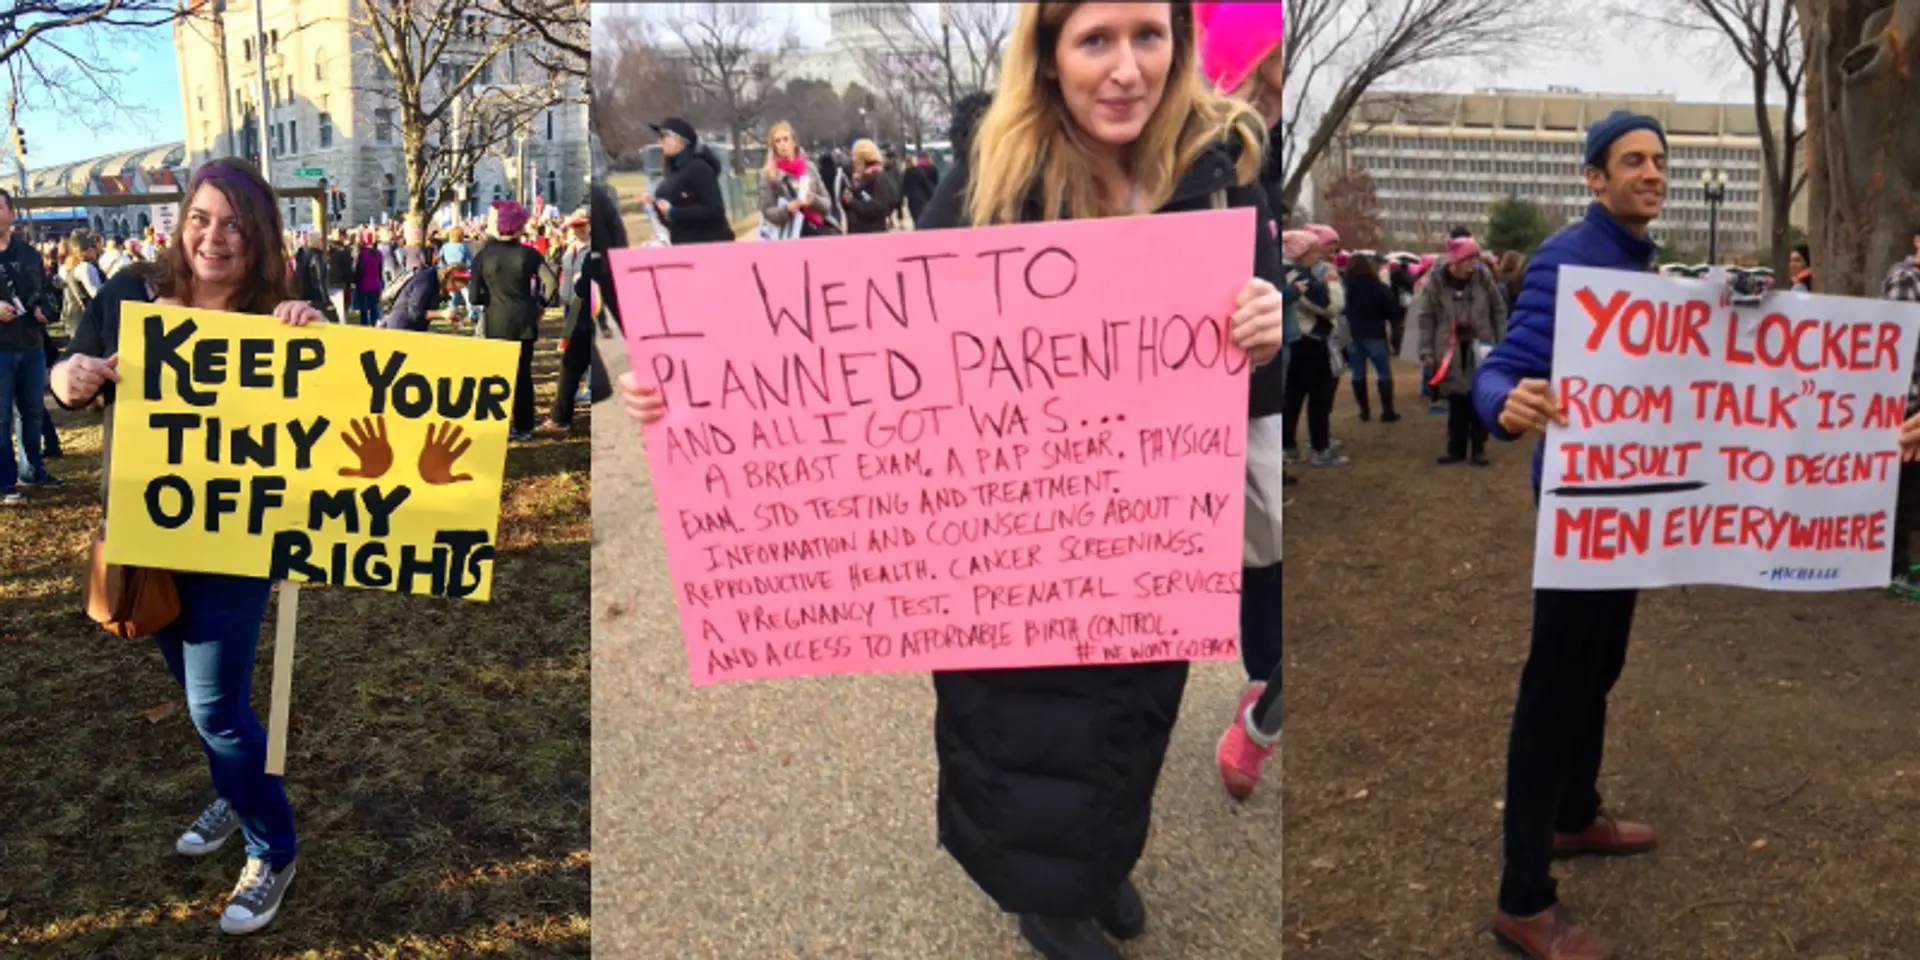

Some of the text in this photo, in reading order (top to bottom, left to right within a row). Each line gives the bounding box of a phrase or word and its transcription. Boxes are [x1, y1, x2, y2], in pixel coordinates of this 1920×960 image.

[628, 246, 1077, 342] I WENT TO
[1574, 286, 1710, 358] YOUR
[143, 315, 511, 421] KEEP YOUR
[651, 346, 921, 411] PLANNED
[665, 422, 736, 466] AND
[752, 412, 806, 450] ALL
[813, 411, 847, 445] I
[865, 405, 954, 449] GOT
[1559, 376, 1672, 429] ROOM
[1815, 391, 1855, 430] IS
[1861, 393, 1906, 430] AN
[148, 412, 331, 469] TINY
[705, 424, 1243, 499] A BREAST EXAM. A PAP SMEAR. PHYSICAL
[1559, 441, 1900, 486] INSULT TO DECENT
[143, 474, 412, 537] OFF MY
[679, 469, 1121, 540] EXAM. STD TESTING AND TREATMENT.
[702, 492, 1231, 573] INFORMATION AND COUNSELING ABOUT MY
[1552, 504, 1888, 560] MEN EVERYWHERE
[269, 530, 496, 599] RIGHTS
[684, 529, 1206, 609] REPRODUCTIVE HEALTH. CANCER SCREENINGS.
[702, 617, 726, 644] A
[736, 602, 876, 636] PREGNANCY
[884, 595, 950, 620] TEST.
[972, 575, 1119, 617] PRENATAL
[706, 610, 1180, 677] AND ACCESS TO AFFORDABLE BIRTH CONTROL.
